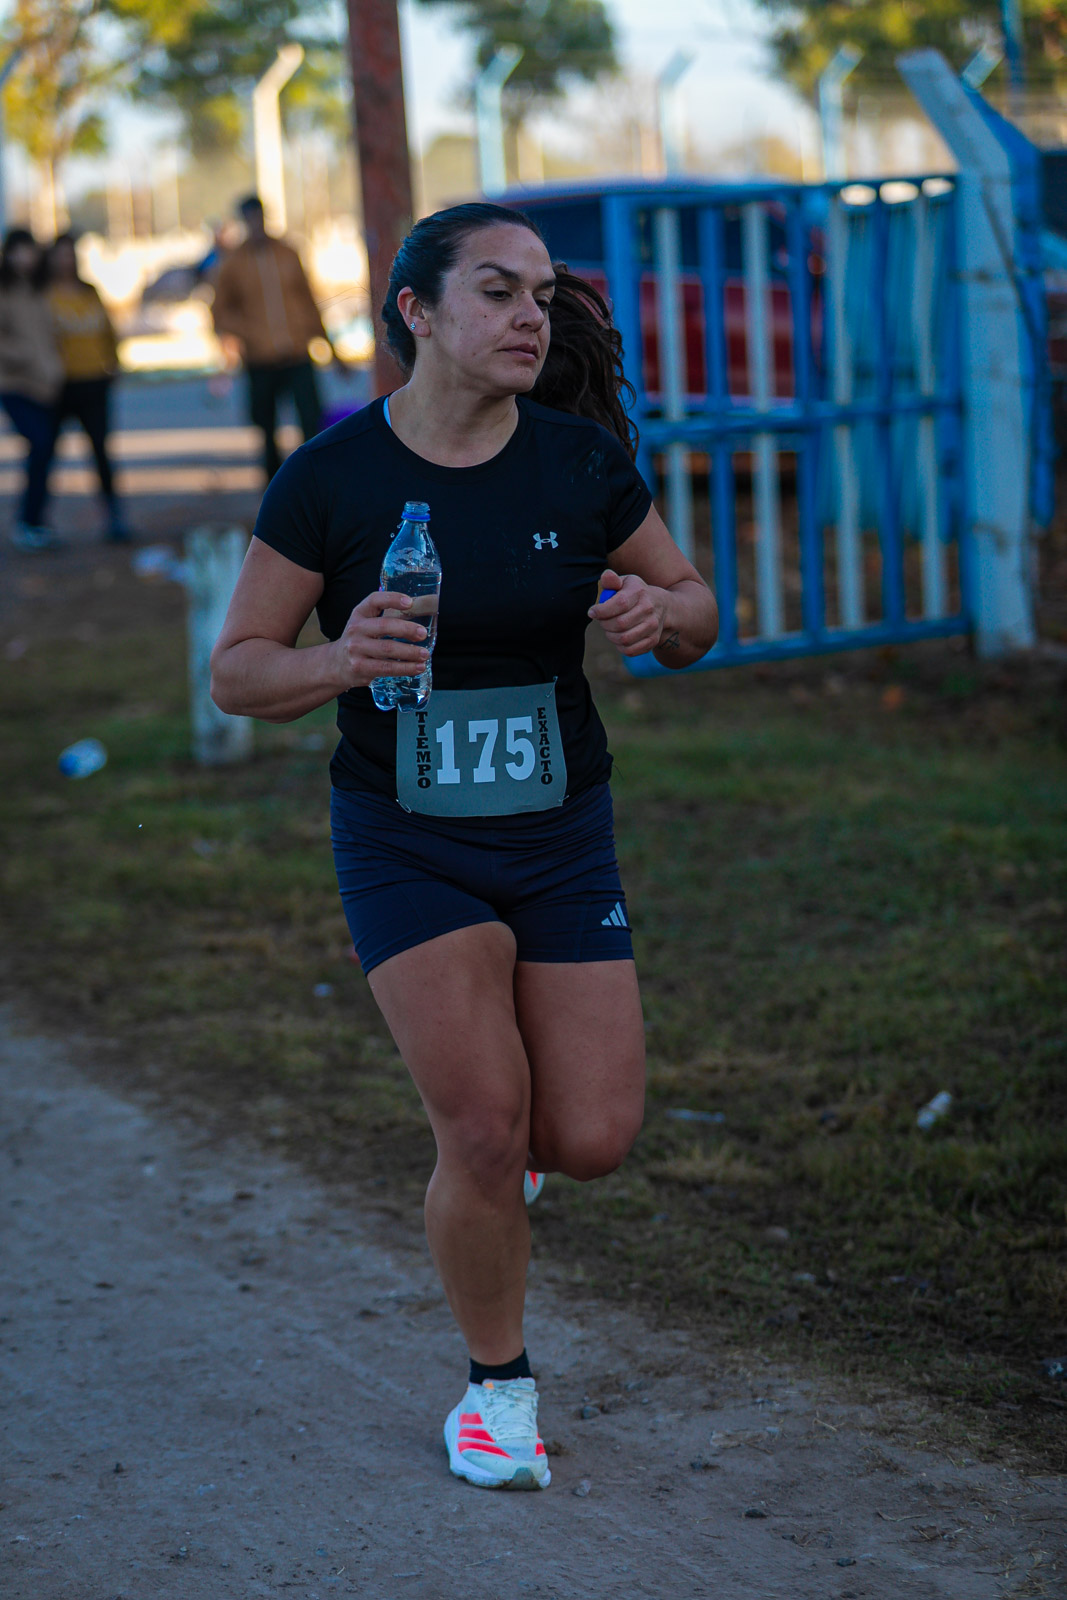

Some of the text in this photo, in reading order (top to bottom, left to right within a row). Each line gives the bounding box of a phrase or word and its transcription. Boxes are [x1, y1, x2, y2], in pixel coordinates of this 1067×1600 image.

[415, 711, 432, 789] TIEMPO
[435, 715, 536, 785] 175
[536, 706, 553, 786] EXACTO
